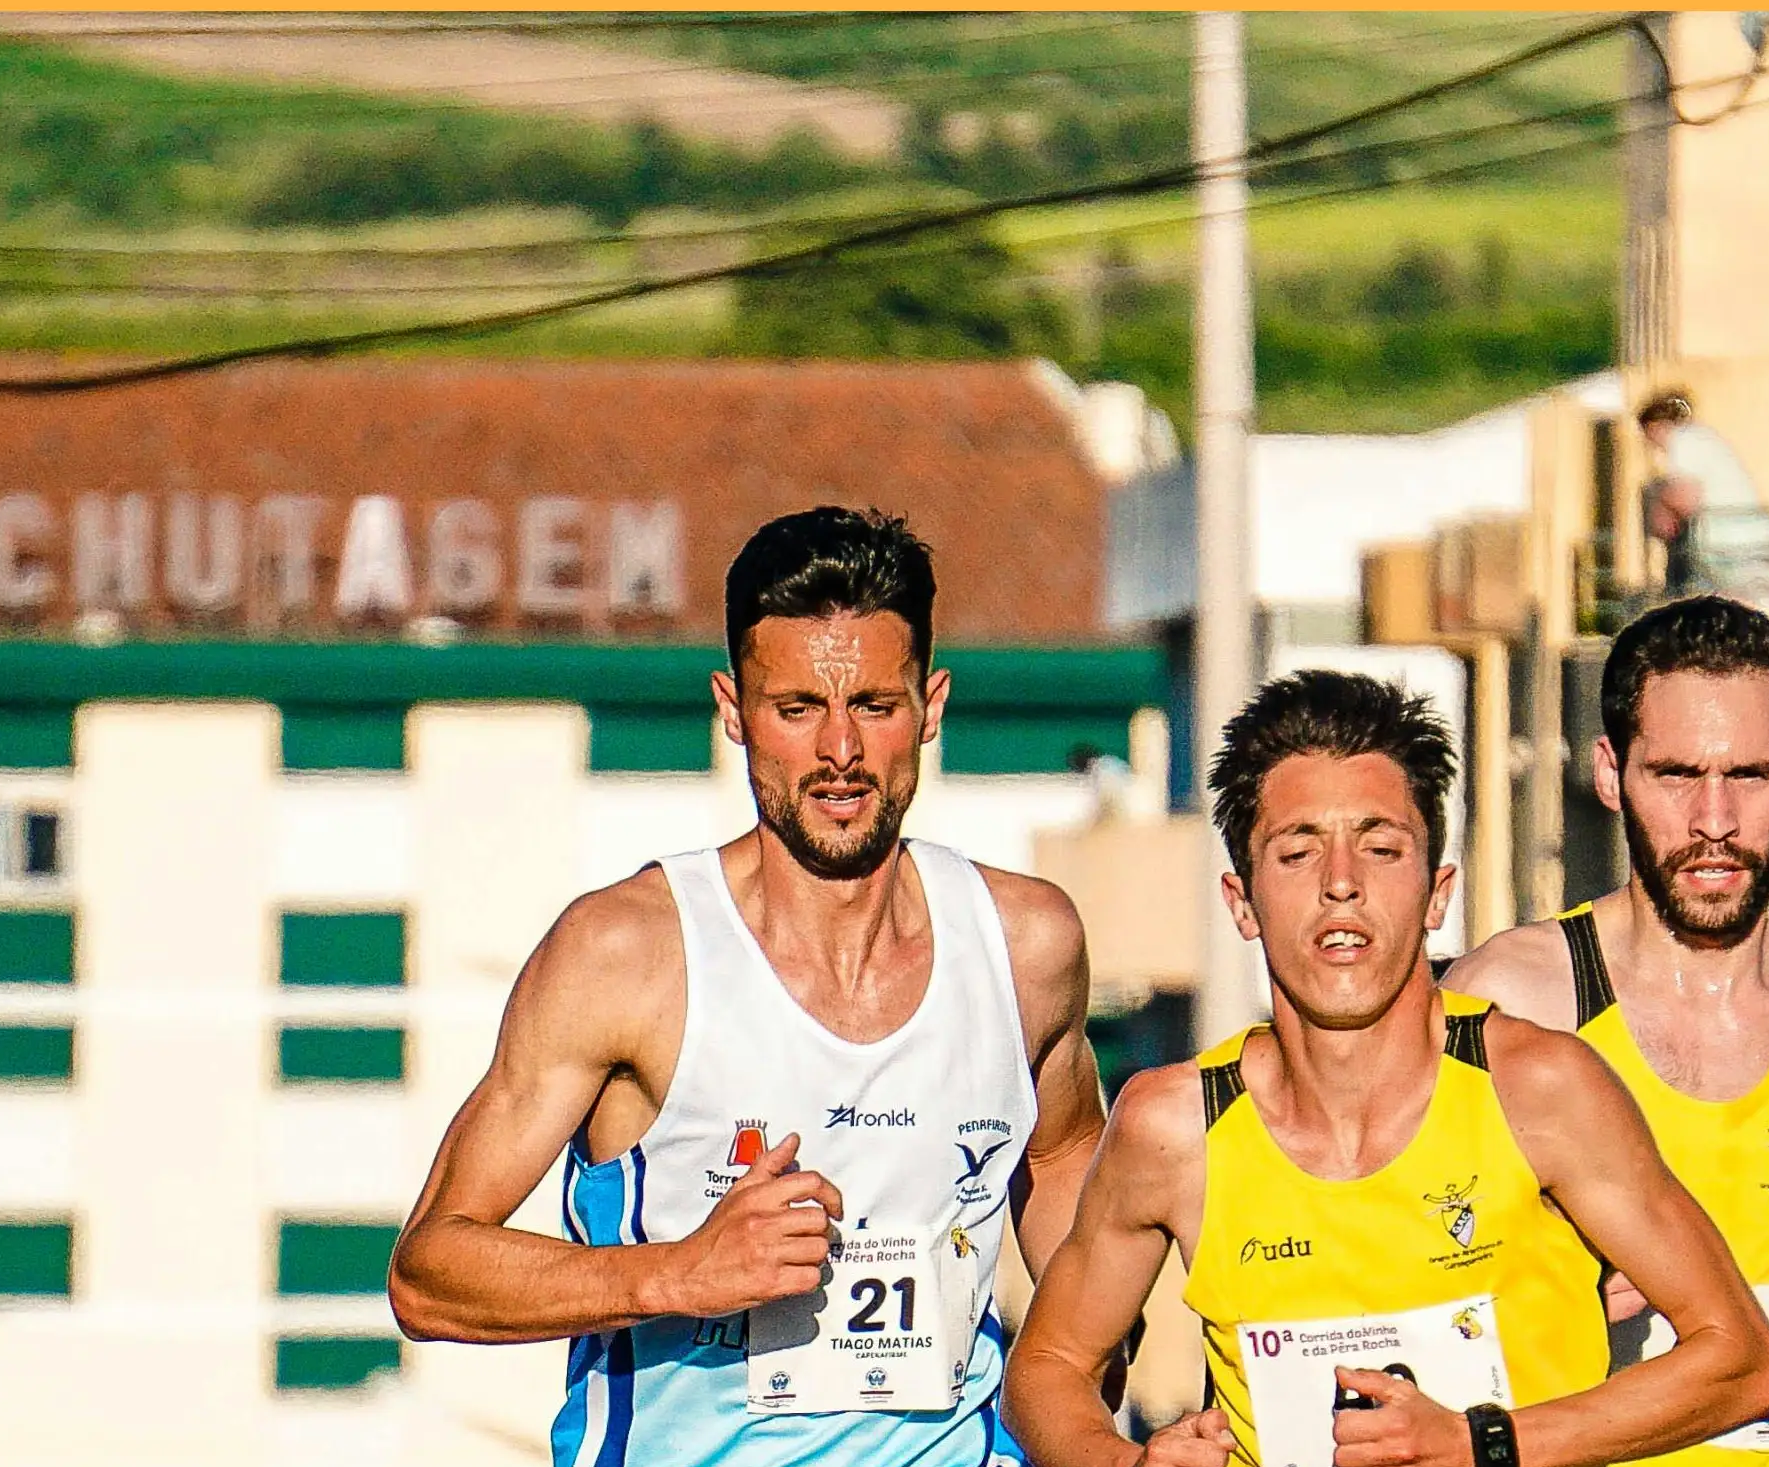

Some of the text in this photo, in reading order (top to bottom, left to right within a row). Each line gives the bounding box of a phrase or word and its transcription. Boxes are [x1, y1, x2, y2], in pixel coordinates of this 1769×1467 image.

[705, 1170, 739, 1185] Torre
[864, 1238, 878, 1249] do
[880, 1236, 916, 1248] Vinho
[877, 1249, 916, 1262] Rocha
[847, 1276, 916, 1333] 21
[831, 1336, 933, 1350] TIAGO MATIAS
[1299, 1330, 1344, 1343] Corrida
[1312, 1346, 1328, 1356] da
[1362, 1338, 1401, 1351] Rocha
